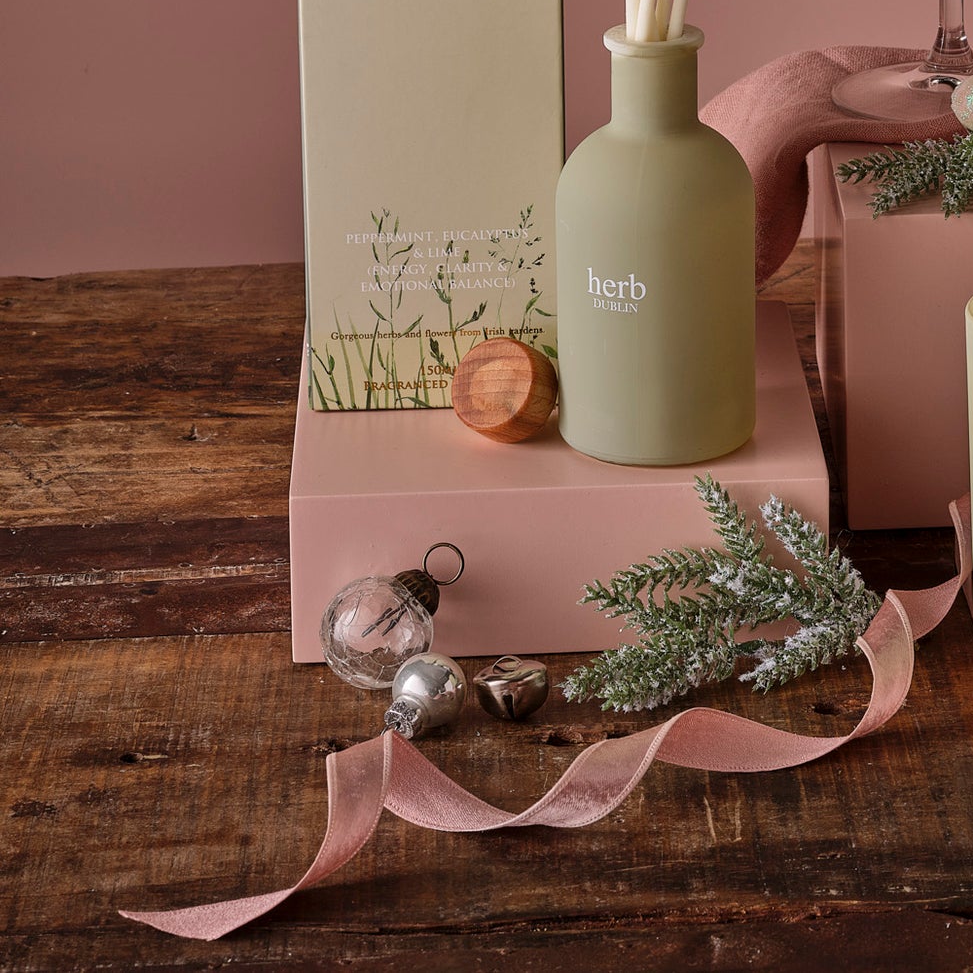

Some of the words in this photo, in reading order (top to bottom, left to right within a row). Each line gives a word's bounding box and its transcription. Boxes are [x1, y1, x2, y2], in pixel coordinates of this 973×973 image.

[443, 229, 529, 242] EUCALYPTUS
[413, 247, 424, 259] &
[428, 247, 461, 258] LIME
[436, 262, 494, 274] CLARITY
[497, 261, 507, 272] &
[361, 279, 445, 292] EMOTIONAL
[449, 277, 516, 289] BALANCE)
[586, 267, 647, 301] herb
[593, 298, 639, 313] DUBLIN
[330, 331, 374, 342] Gorgeous
[376, 331, 402, 339] herbs
[405, 330, 422, 339] and
[425, 329, 457, 339] flowers
[459, 328, 481, 337] from
[486, 327, 505, 336] Irish
[363, 379, 449, 392] FRAGRANCED
